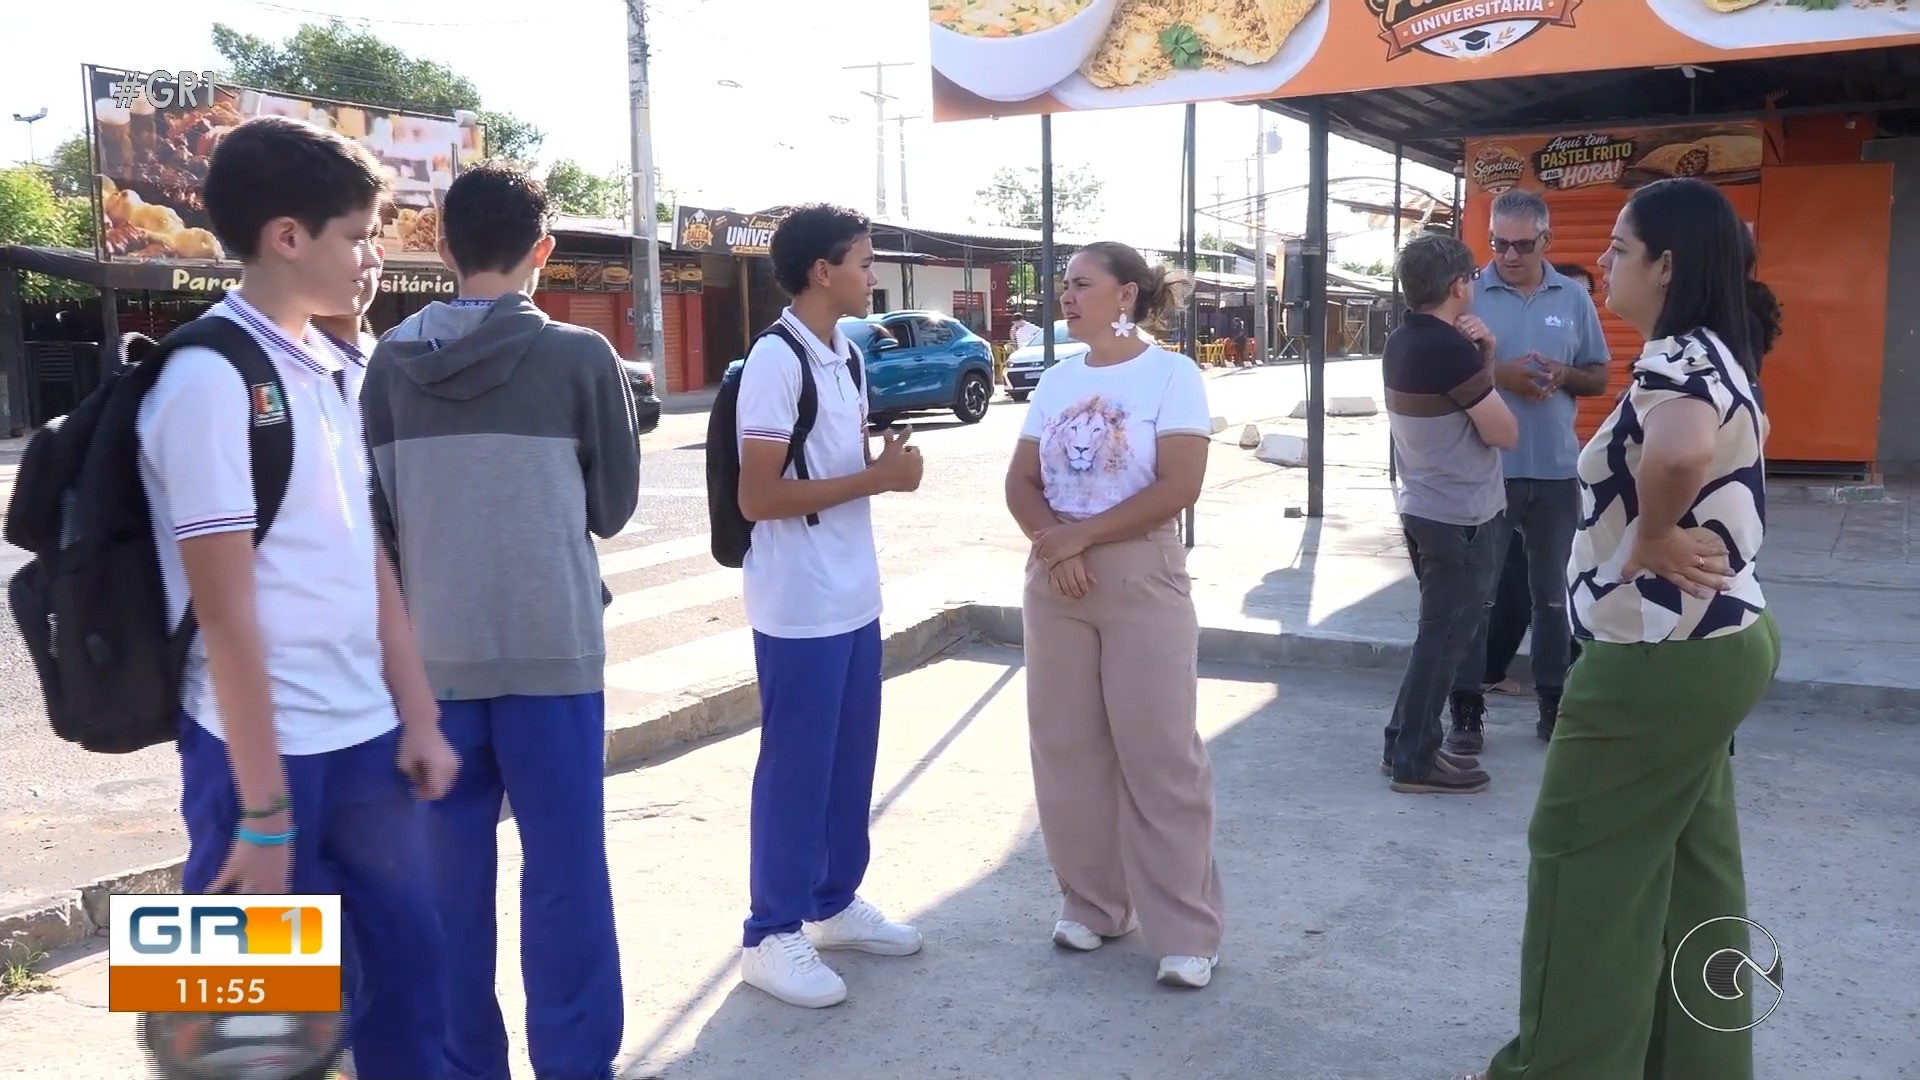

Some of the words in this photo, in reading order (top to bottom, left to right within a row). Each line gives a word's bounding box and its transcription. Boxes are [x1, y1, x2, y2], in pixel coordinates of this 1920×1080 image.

[1547, 136, 1582, 152] Aqui
[1585, 133, 1609, 146] tem
[1541, 148, 1591, 169] PASTEL
[1592, 142, 1632, 161] FRITO
[1545, 170, 1560, 178] na
[1561, 159, 1620, 187] HORA!
[748, 215, 779, 231] Lanch
[172, 268, 245, 291] Para
[381, 274, 454, 293] sitária
